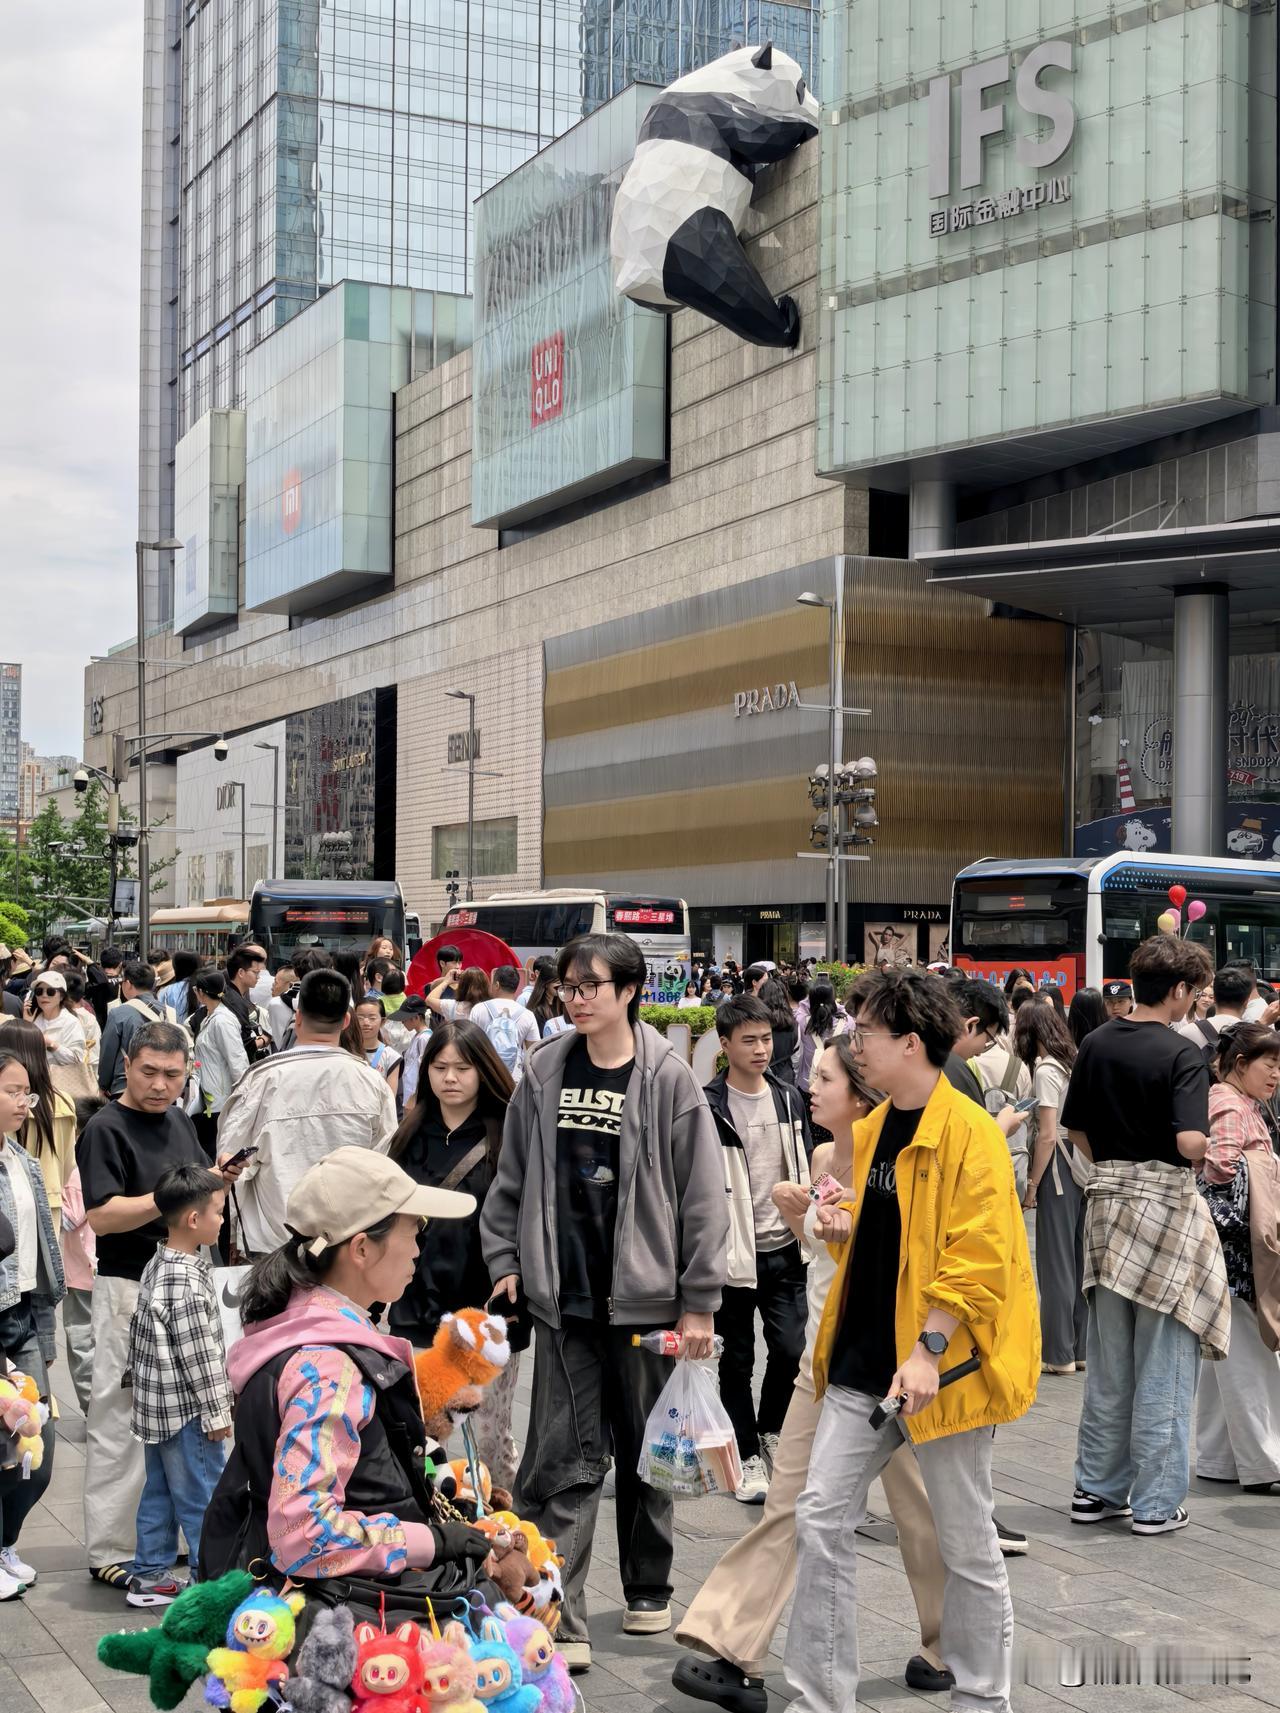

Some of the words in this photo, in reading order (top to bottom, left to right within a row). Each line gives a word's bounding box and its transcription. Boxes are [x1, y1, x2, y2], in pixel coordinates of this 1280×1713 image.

[929, 39, 1074, 200] IFS
[929, 176, 1071, 238] 国际金融中心
[535, 345, 558, 380] UNI
[535, 379, 560, 418] QLO
[734, 681, 801, 718] PRADA
[447, 729, 481, 764] FENDI
[1235, 757, 1280, 768] SNOOPY
[903, 910, 942, 920] PRADA
[559, 1089, 626, 1113] ELLST
